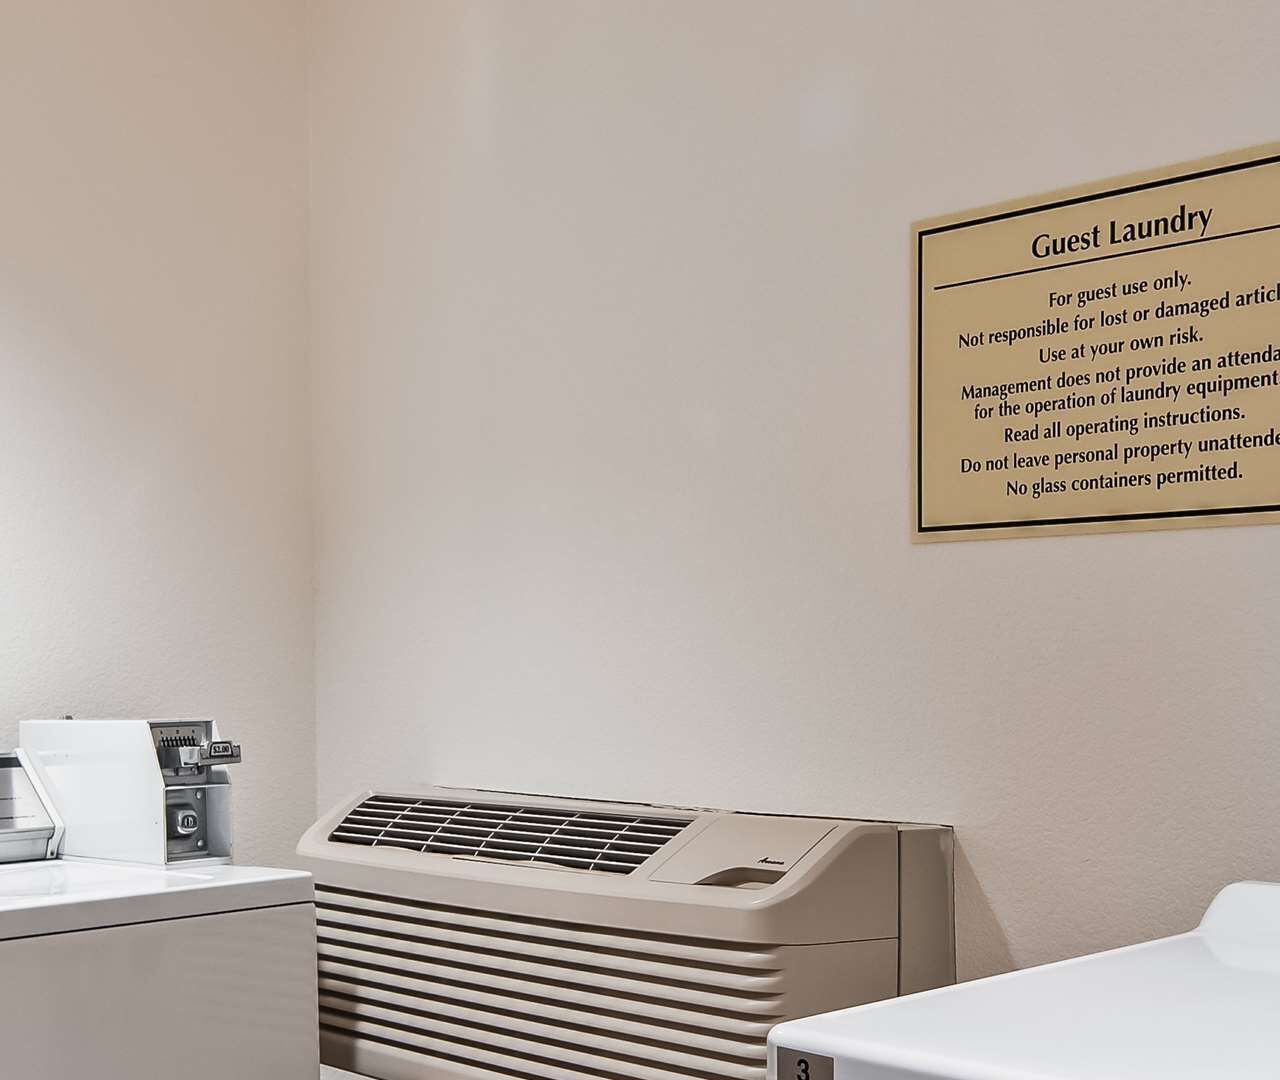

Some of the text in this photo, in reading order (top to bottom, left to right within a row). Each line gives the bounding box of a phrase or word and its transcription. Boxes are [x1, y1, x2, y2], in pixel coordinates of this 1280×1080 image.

[1032, 204, 1213, 258] Guest Laundry
[1049, 270, 1192, 308] For guest use only.
[959, 332, 984, 348] Not
[989, 317, 1069, 346] responsible
[1073, 314, 1095, 331] for
[1101, 309, 1128, 327] lost
[1133, 309, 1150, 322] or
[1155, 291, 1229, 319] damaged
[1039, 326, 1203, 363] Use at your own risk.
[961, 376, 1052, 401] Management
[1057, 371, 1090, 389] does
[1096, 366, 1120, 384] not
[1126, 357, 1186, 385] provide
[1192, 358, 1211, 372] an
[974, 403, 994, 419] for
[998, 400, 1021, 417] the
[1025, 392, 1095, 418] operation
[1100, 387, 1117, 405] of
[1121, 381, 1181, 403] laundry
[1005, 405, 1245, 443] Read all operating instructions.
[961, 458, 981, 473] Do
[986, 456, 1009, 471] not
[1014, 452, 1050, 469] leave
[1055, 443, 1118, 470] personal
[1124, 439, 1193, 464] property
[1007, 461, 1243, 499] No glass containers permitted.
